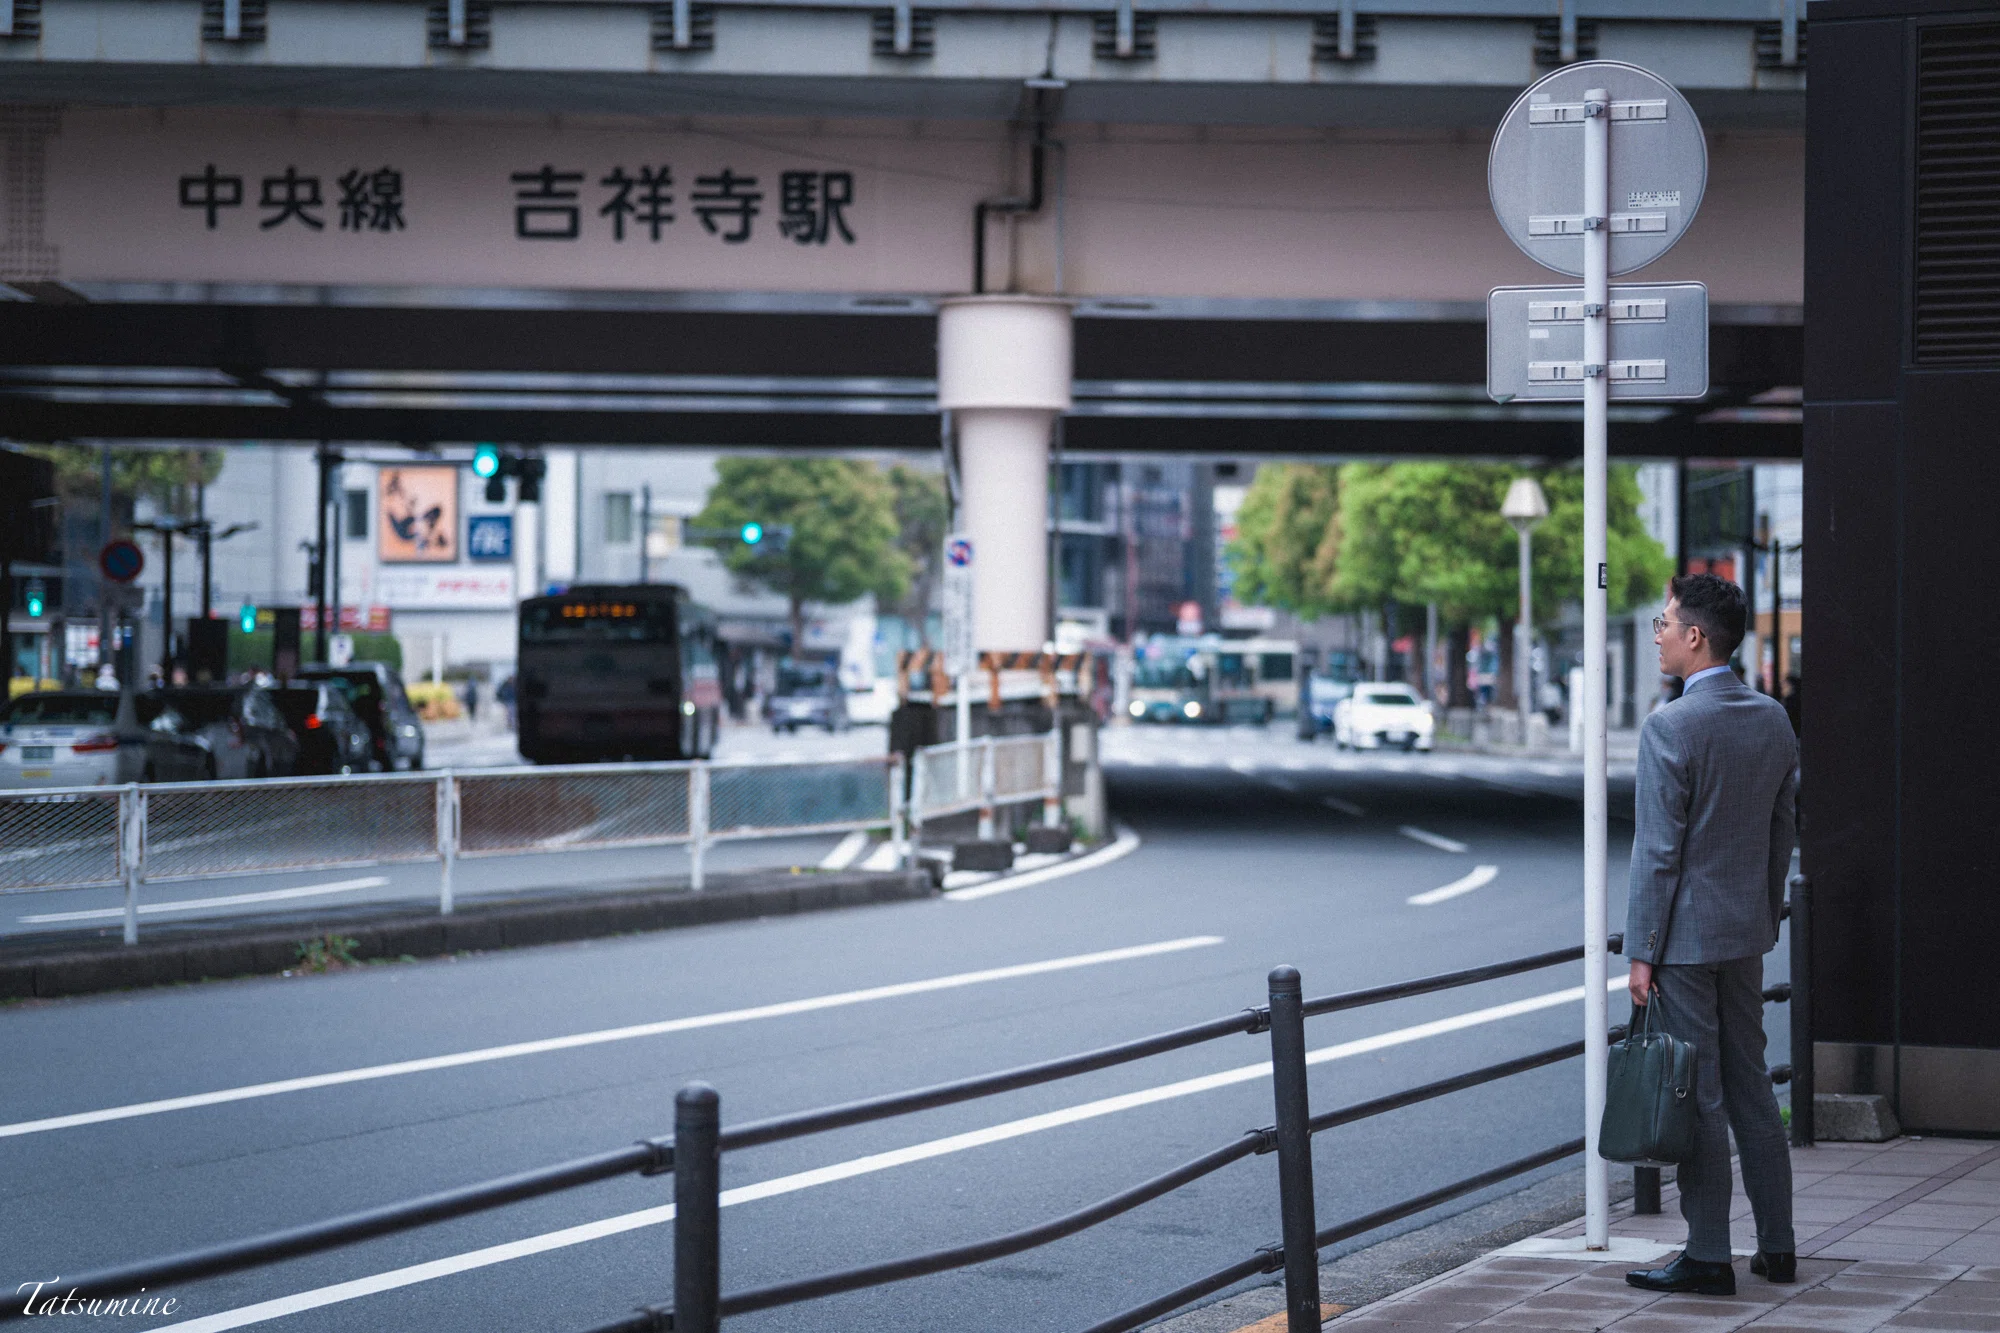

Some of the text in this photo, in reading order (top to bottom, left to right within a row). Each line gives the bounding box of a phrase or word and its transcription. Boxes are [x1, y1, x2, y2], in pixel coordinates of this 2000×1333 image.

[178, 165, 857, 245] 中央線 吉祥寺駅
